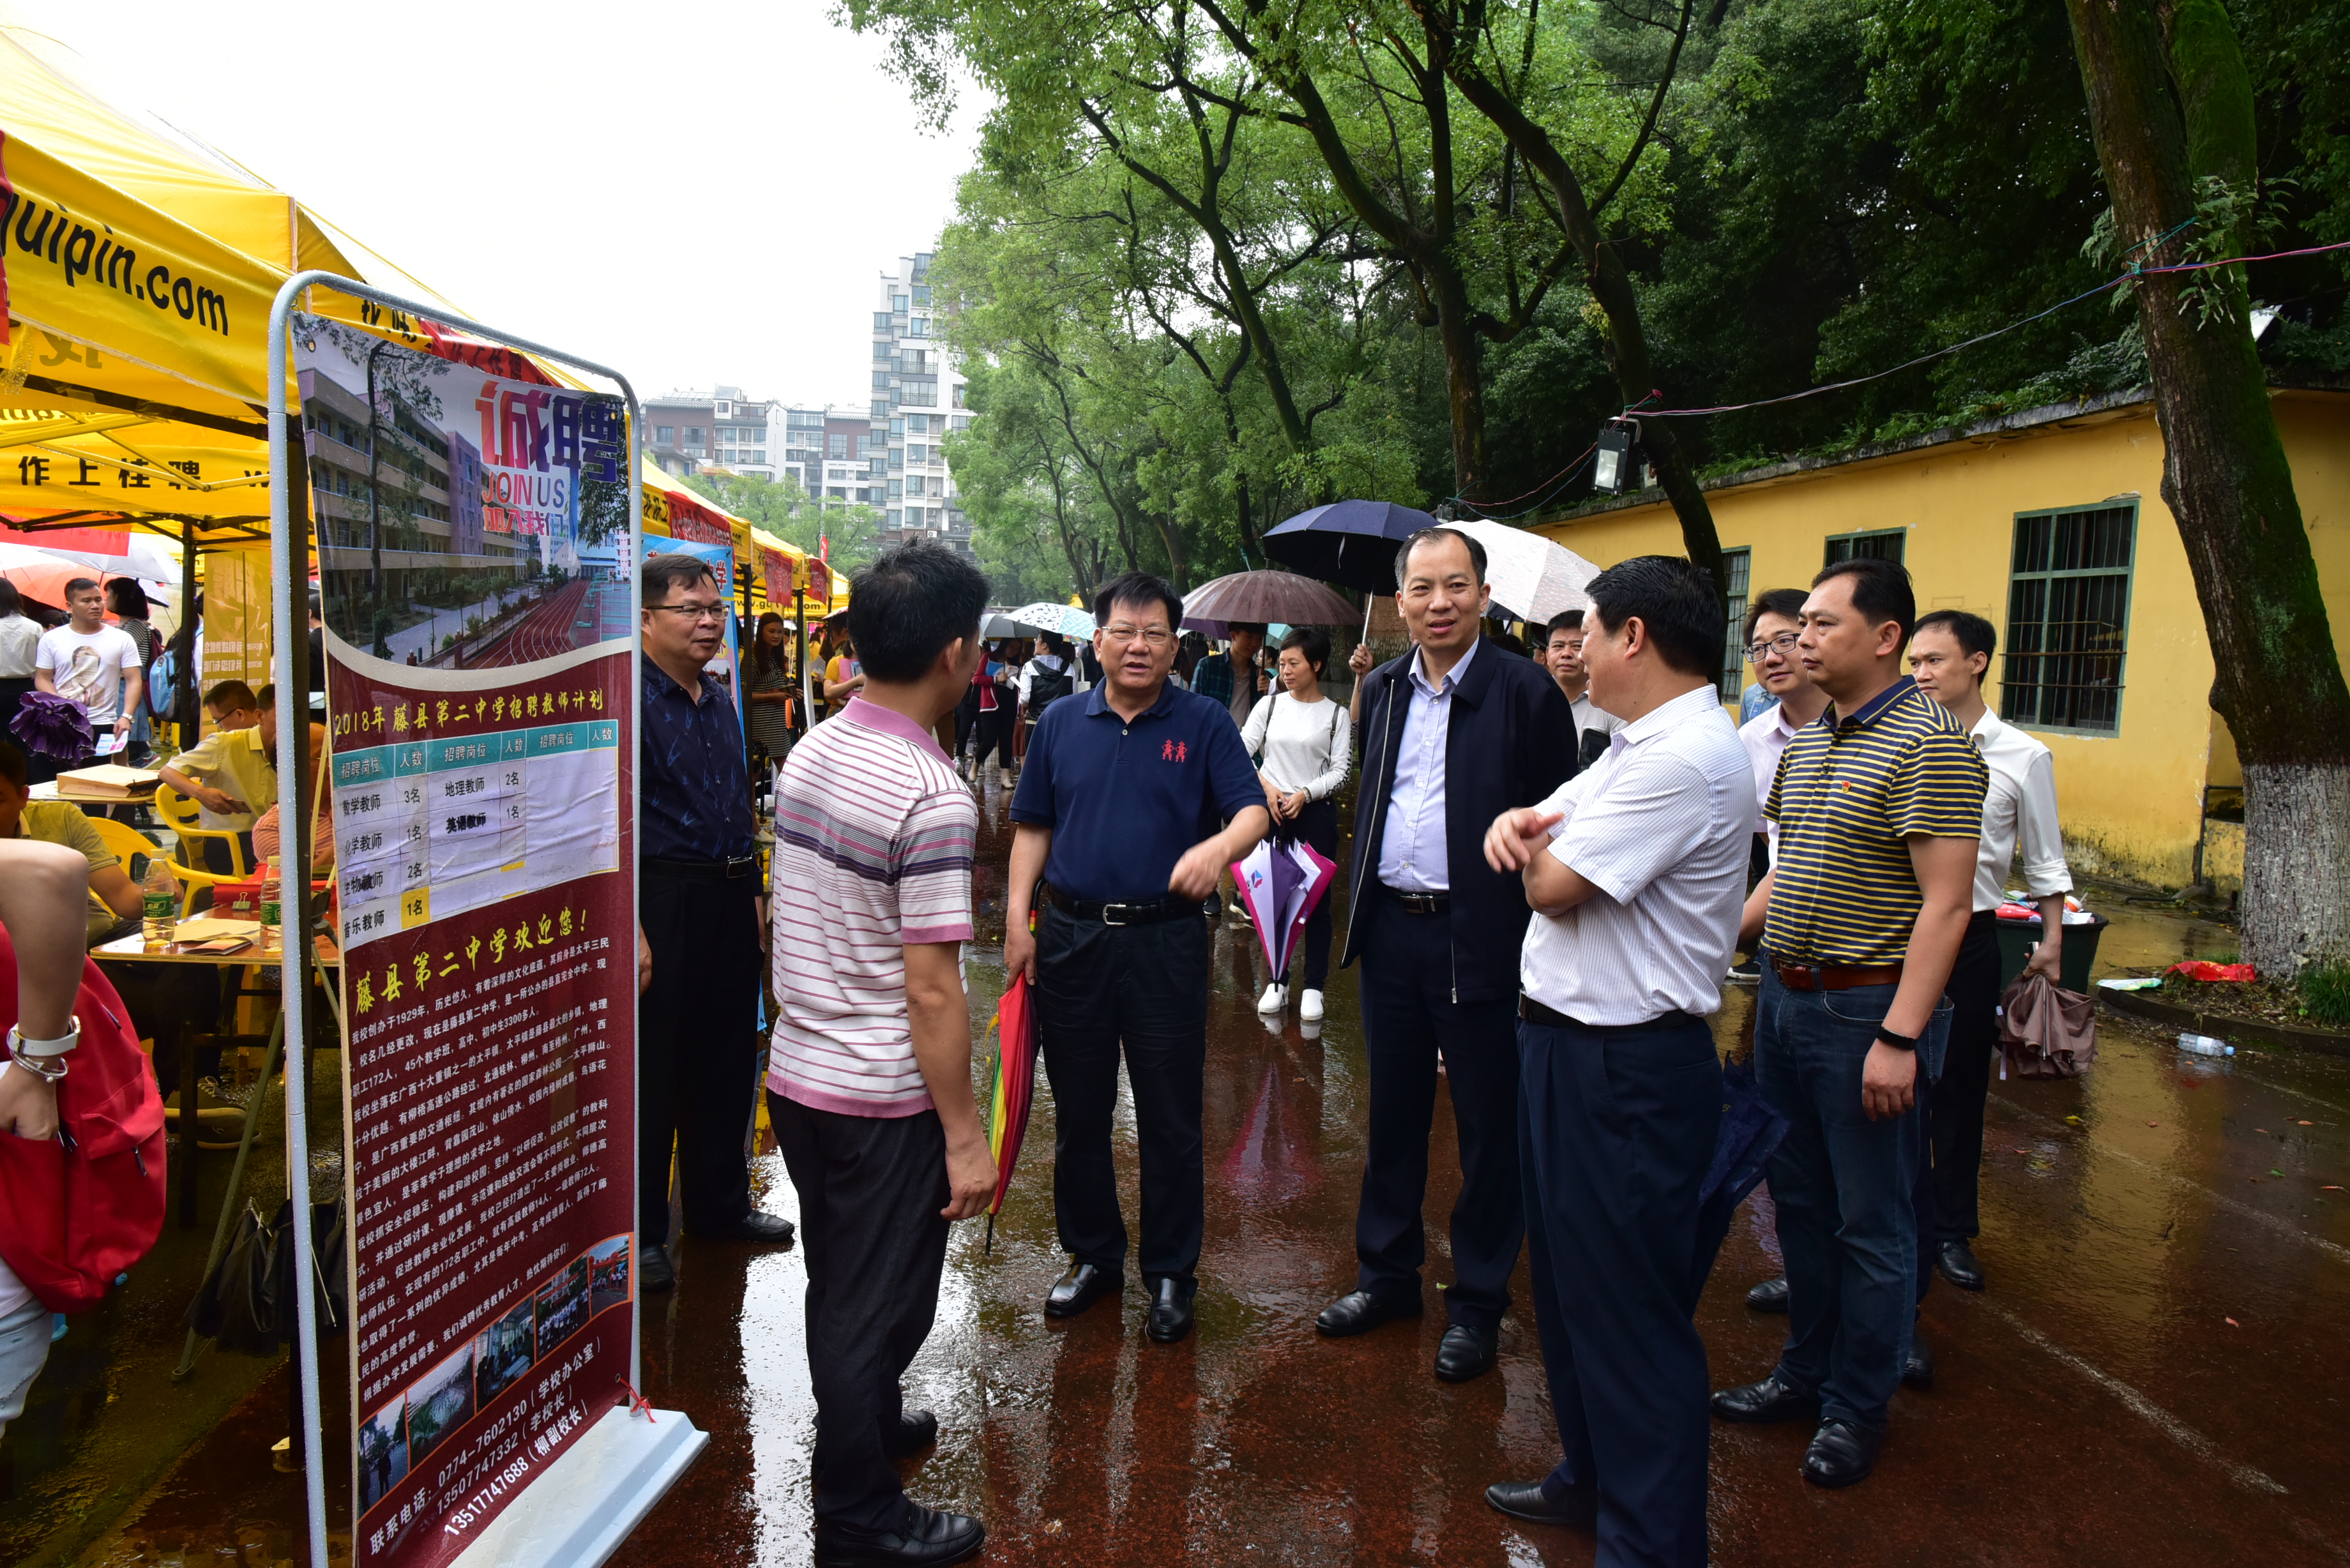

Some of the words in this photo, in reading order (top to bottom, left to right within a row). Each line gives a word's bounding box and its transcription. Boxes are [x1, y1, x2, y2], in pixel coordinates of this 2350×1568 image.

[475, 379, 619, 508] 诚聘
[481, 471, 533, 506] JOIN
[537, 477, 565, 508] US
[483, 505, 564, 536] 加入我们
[540, 731, 574, 748] 招聘岗位
[591, 727, 612, 741] 人数
[444, 743, 487, 762] 招聘岗位
[505, 737, 523, 753] 人数
[341, 757, 380, 779] 招聘岗位
[400, 750, 422, 768] 人数
[444, 776, 485, 797] 地理教师
[506, 771, 519, 786] 2名
[342, 793, 381, 817] 数学教师
[404, 787, 421, 804] 3名
[446, 811, 486, 833] 英语教师
[506, 804, 520, 820] 1名
[407, 824, 422, 841] 1名
[344, 832, 382, 856] 化学教师
[407, 862, 422, 878] 2名
[407, 899, 423, 916] 1名
[344, 909, 384, 940] 音乐教师
[351, 1007, 540, 1099] 职工172人，45个教学班，高中、初中生3300多人。
[356, 1119, 607, 1279] 式，并通过研讨课、观摩课、示范课和经验交流会等不同形式、不同层次
[356, 1139, 607, 1304] 研活动，促进教师专业化发展。我校已经打造出了一支爱岗敬业、师德高
[356, 1166, 600, 1331] 教师队伍。在现有的172名职工中，就有高级教师14人，一级教师72人。
